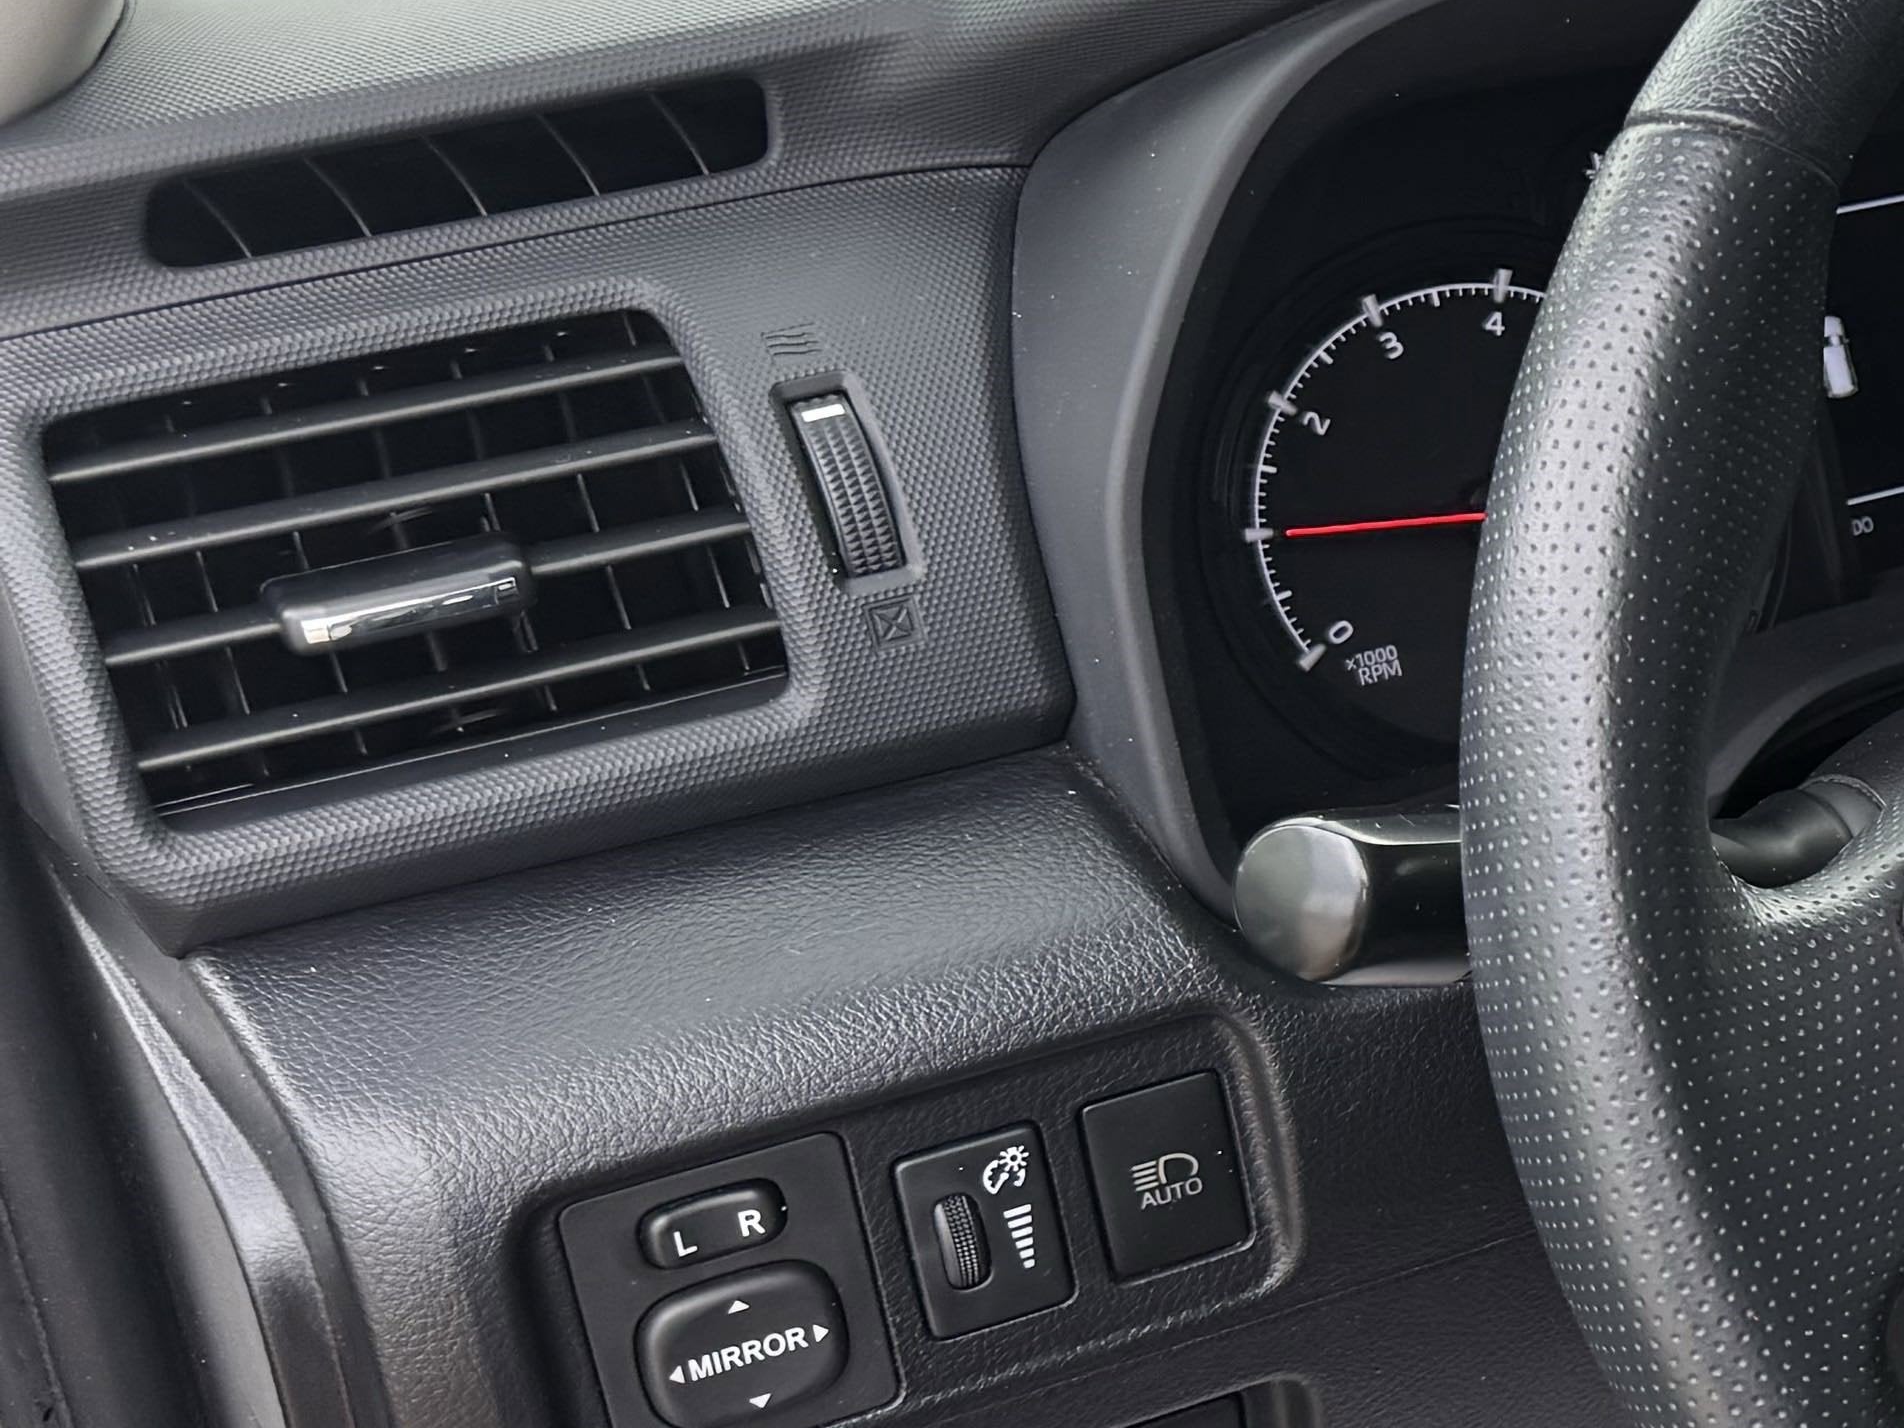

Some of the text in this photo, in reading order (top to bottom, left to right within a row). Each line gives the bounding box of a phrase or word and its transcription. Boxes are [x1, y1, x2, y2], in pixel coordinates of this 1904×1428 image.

[1483, 311, 1506, 337] 4
[1377, 331, 1405, 360] 3
[1302, 411, 1331, 436] 2
[1327, 620, 1354, 645] 0
[1357, 659, 1402, 686] RPM
[1141, 1177, 1203, 1210] AUTO
[673, 1209, 766, 1257] L R
[688, 1326, 809, 1381] MIRROR
